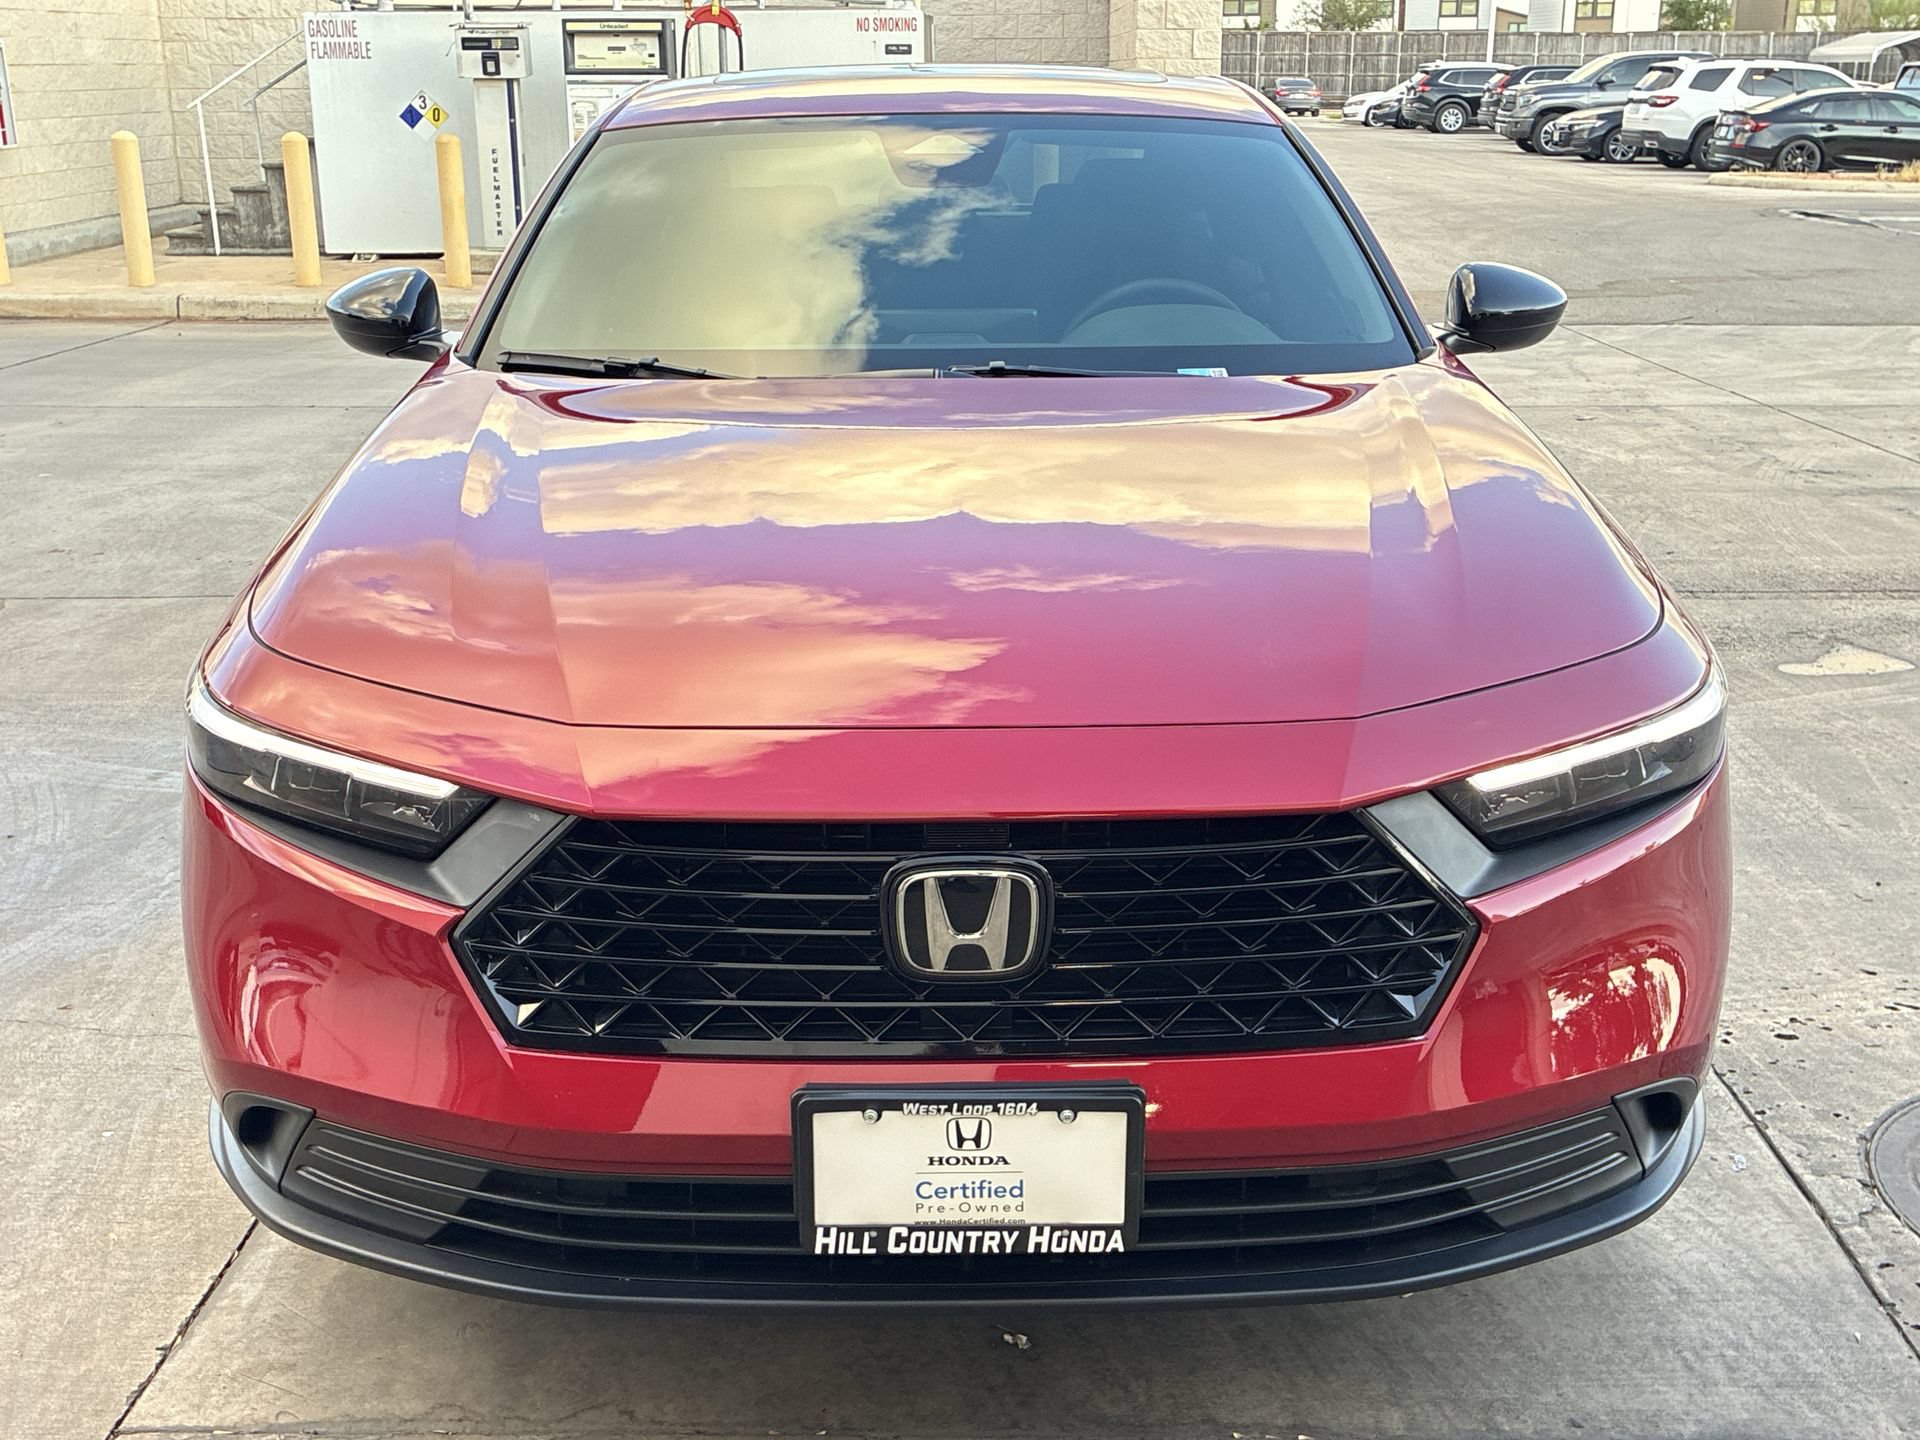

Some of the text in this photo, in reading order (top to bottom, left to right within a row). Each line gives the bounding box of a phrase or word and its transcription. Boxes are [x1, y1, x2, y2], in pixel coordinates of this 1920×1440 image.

[308, 19, 358, 38] GASOLINE
[856, 17, 918, 32] NO SMOKING
[311, 41, 372, 59] FLAMMABLE
[418, 95, 427, 110] 3
[432, 107, 441, 122] 0
[491, 148, 503, 236] FUELMASTER
[996, 1102, 1039, 1116] 1604
[927, 1156, 1011, 1166] HONDA
[915, 1179, 1024, 1200] Certified
[915, 1201, 1024, 1214] Pre-Owned
[914, 1217, 1026, 1226] www.HondaCertified.com
[814, 1225, 1125, 1255] HILL COUNTRY HONDA
